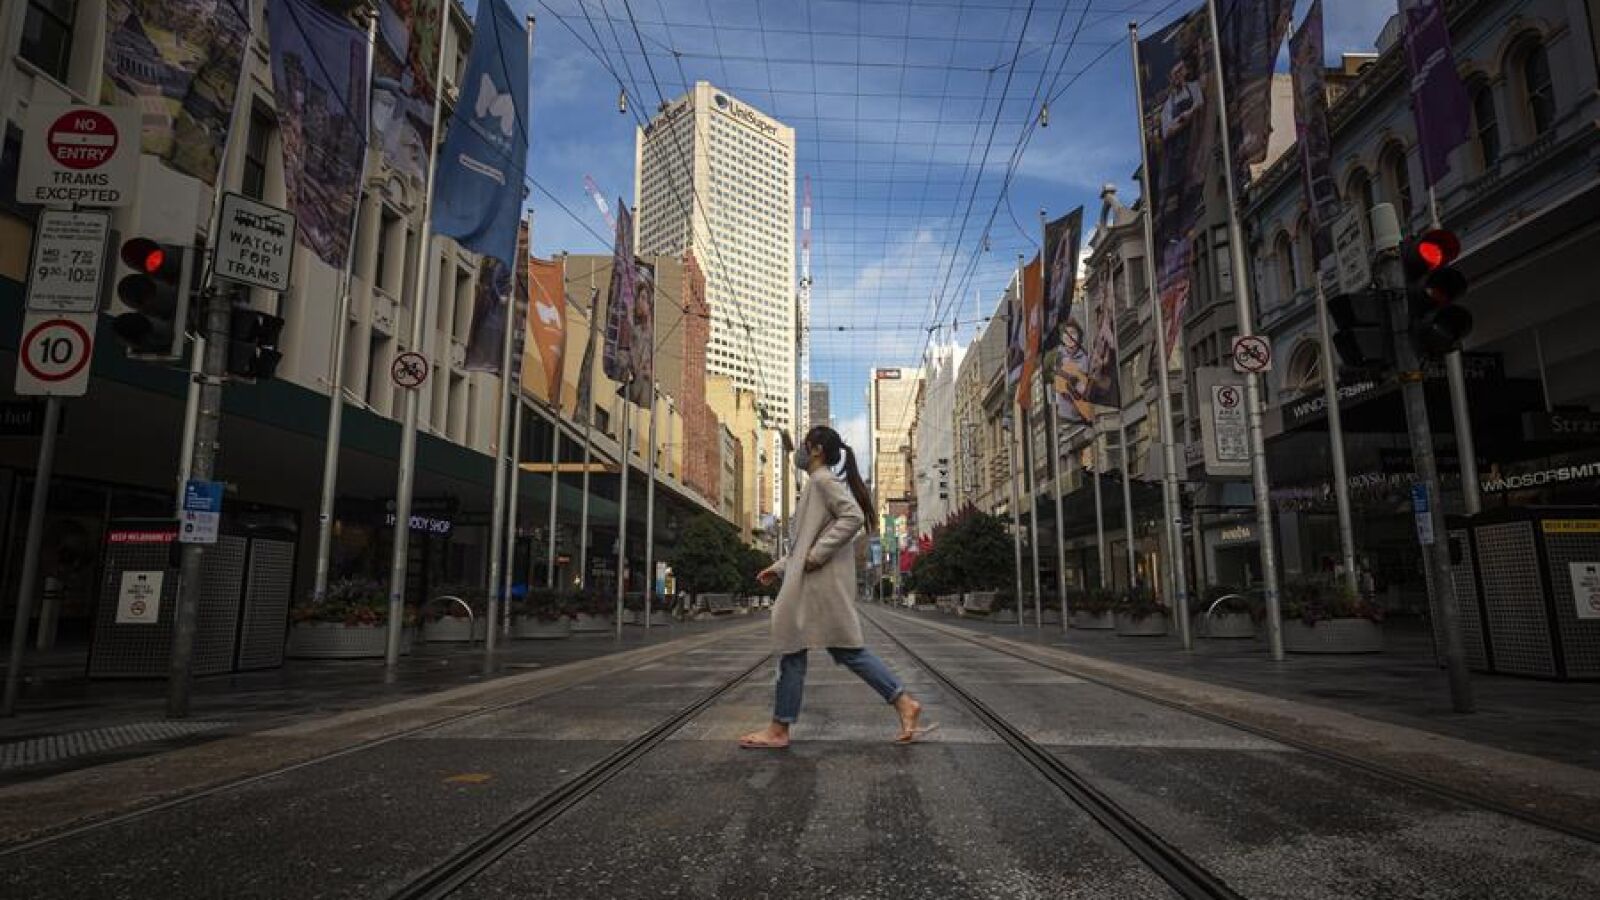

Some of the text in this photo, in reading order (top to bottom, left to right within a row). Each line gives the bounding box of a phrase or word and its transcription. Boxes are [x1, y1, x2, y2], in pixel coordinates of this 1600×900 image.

[74, 118, 97, 130] NO
[728, 100, 777, 135] UniSuper
[57, 146, 108, 160] ENTRY
[53, 171, 109, 185] TRAMS
[35, 186, 120, 201] EXCEPTED
[230, 231, 284, 256] WATCH
[240, 248, 271, 266] FOR
[228, 258, 280, 283] TRAMS
[40, 337, 73, 364] 10
[430, 518, 450, 532] SHOP
